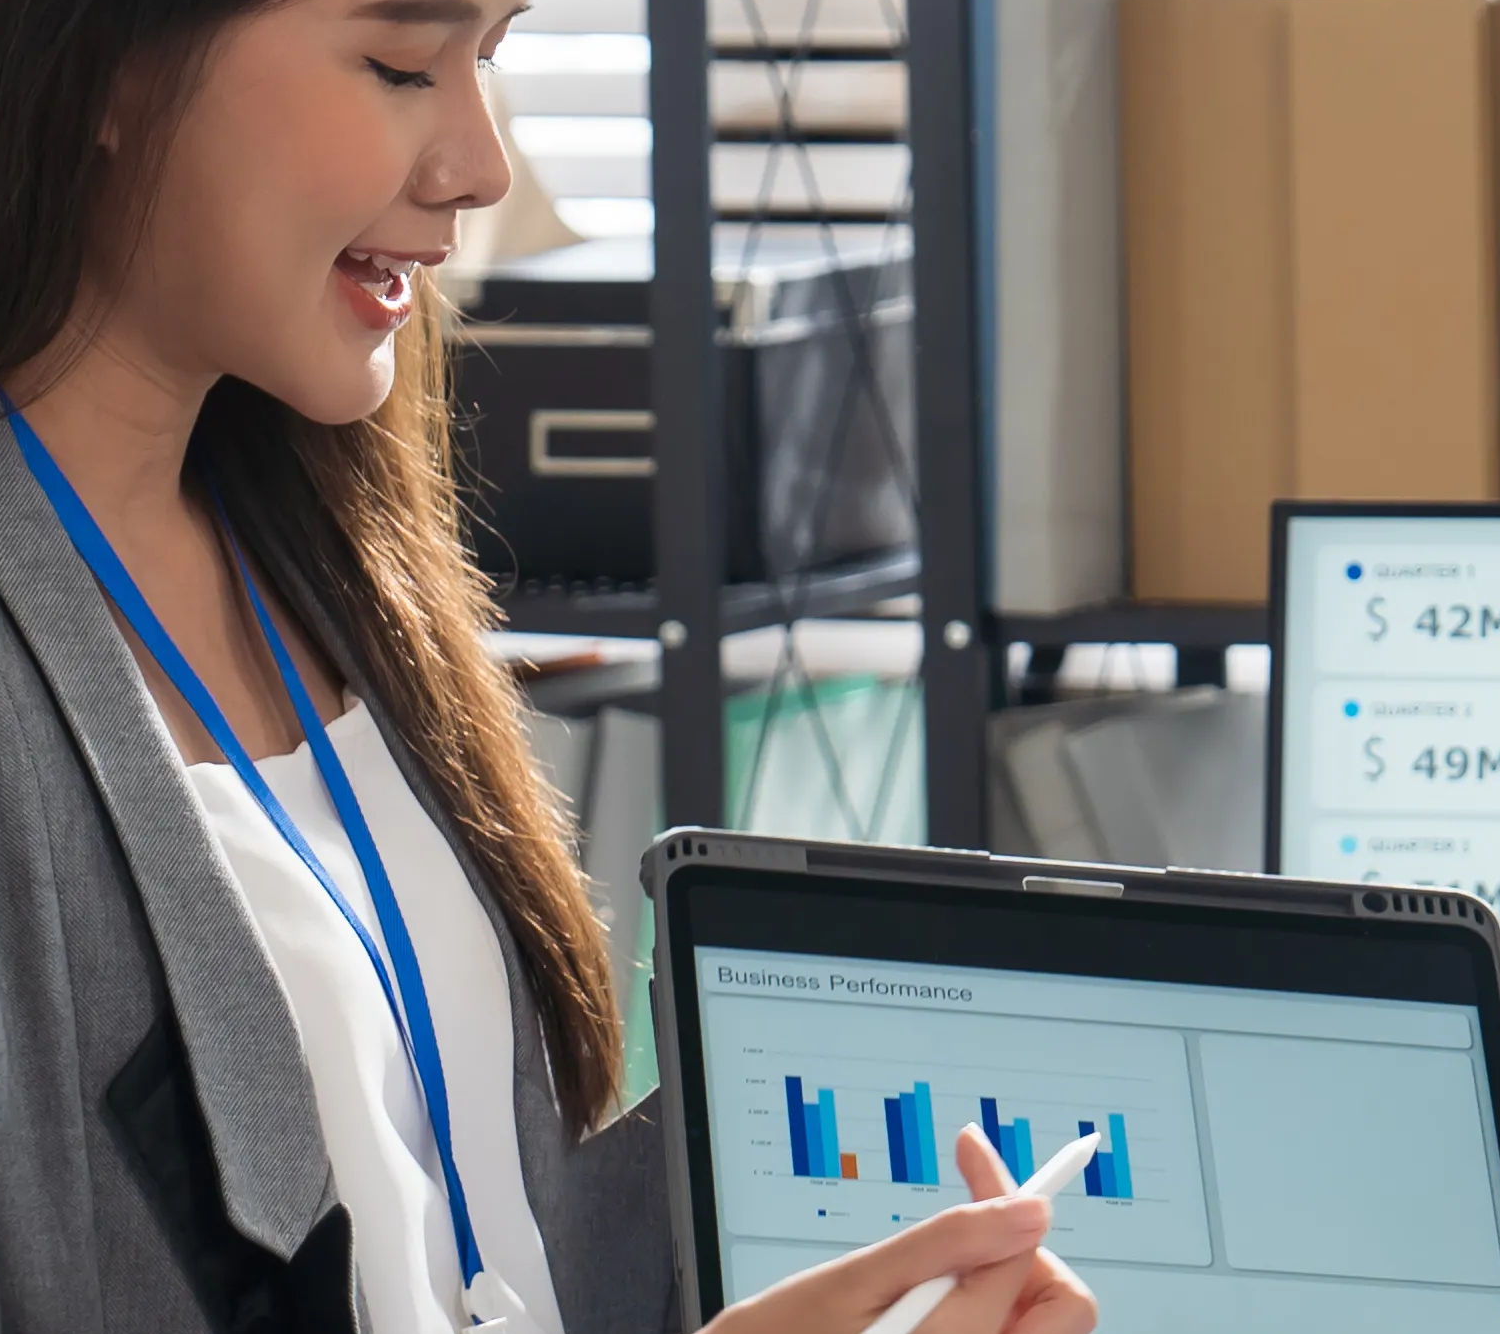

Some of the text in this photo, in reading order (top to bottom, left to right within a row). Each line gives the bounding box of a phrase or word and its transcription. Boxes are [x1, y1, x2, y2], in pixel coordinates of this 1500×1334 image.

[1366, 595, 1388, 642] $
[1364, 734, 1386, 782] $
[718, 966, 973, 1002] Business Performance
